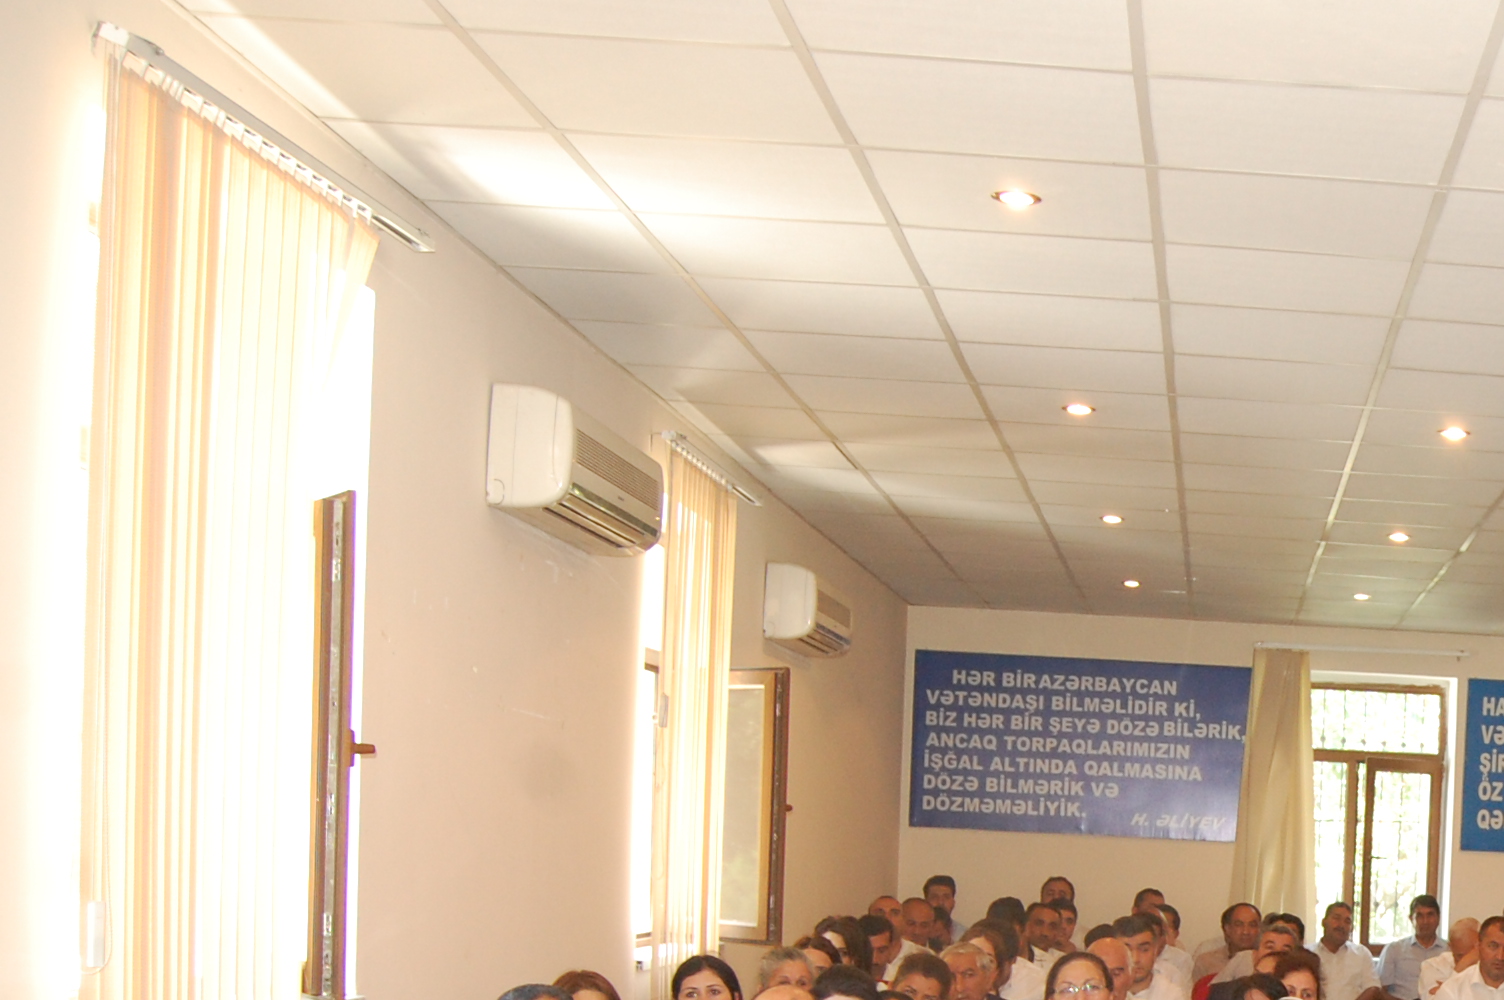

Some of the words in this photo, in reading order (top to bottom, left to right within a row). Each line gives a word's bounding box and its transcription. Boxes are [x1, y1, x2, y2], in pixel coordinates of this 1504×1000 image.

[952, 669, 995, 688] HƏR
[1002, 669, 1038, 689] BİR
[1039, 673, 1177, 696] AZƏRBAYCAN
[926, 690, 1044, 712] VƏTƏNDAŞI
[1052, 693, 1168, 715] BİLMƏLİDİR
[1174, 699, 1201, 720] Kİ,
[925, 710, 957, 727] BİZ
[963, 713, 1005, 729] HƏR
[1010, 711, 1043, 731] BİR
[1049, 715, 1100, 736] ŞEYƏ
[1106, 715, 1159, 736] DÖZƏ
[926, 731, 997, 751] ANCAQ
[1004, 736, 1190, 759] TORPAQLARIMIZIN
[989, 757, 1077, 775] ALTINDA
[1084, 761, 1202, 781] QALMASINA
[923, 774, 979, 791] DÖZƏ
[985, 775, 1084, 797] BİLMƏRİK
[1091, 782, 1119, 798] VƏ
[1478, 776, 1502, 801] ÖZ
[922, 794, 1087, 819] DÖZMƏMƏLİYİK.
